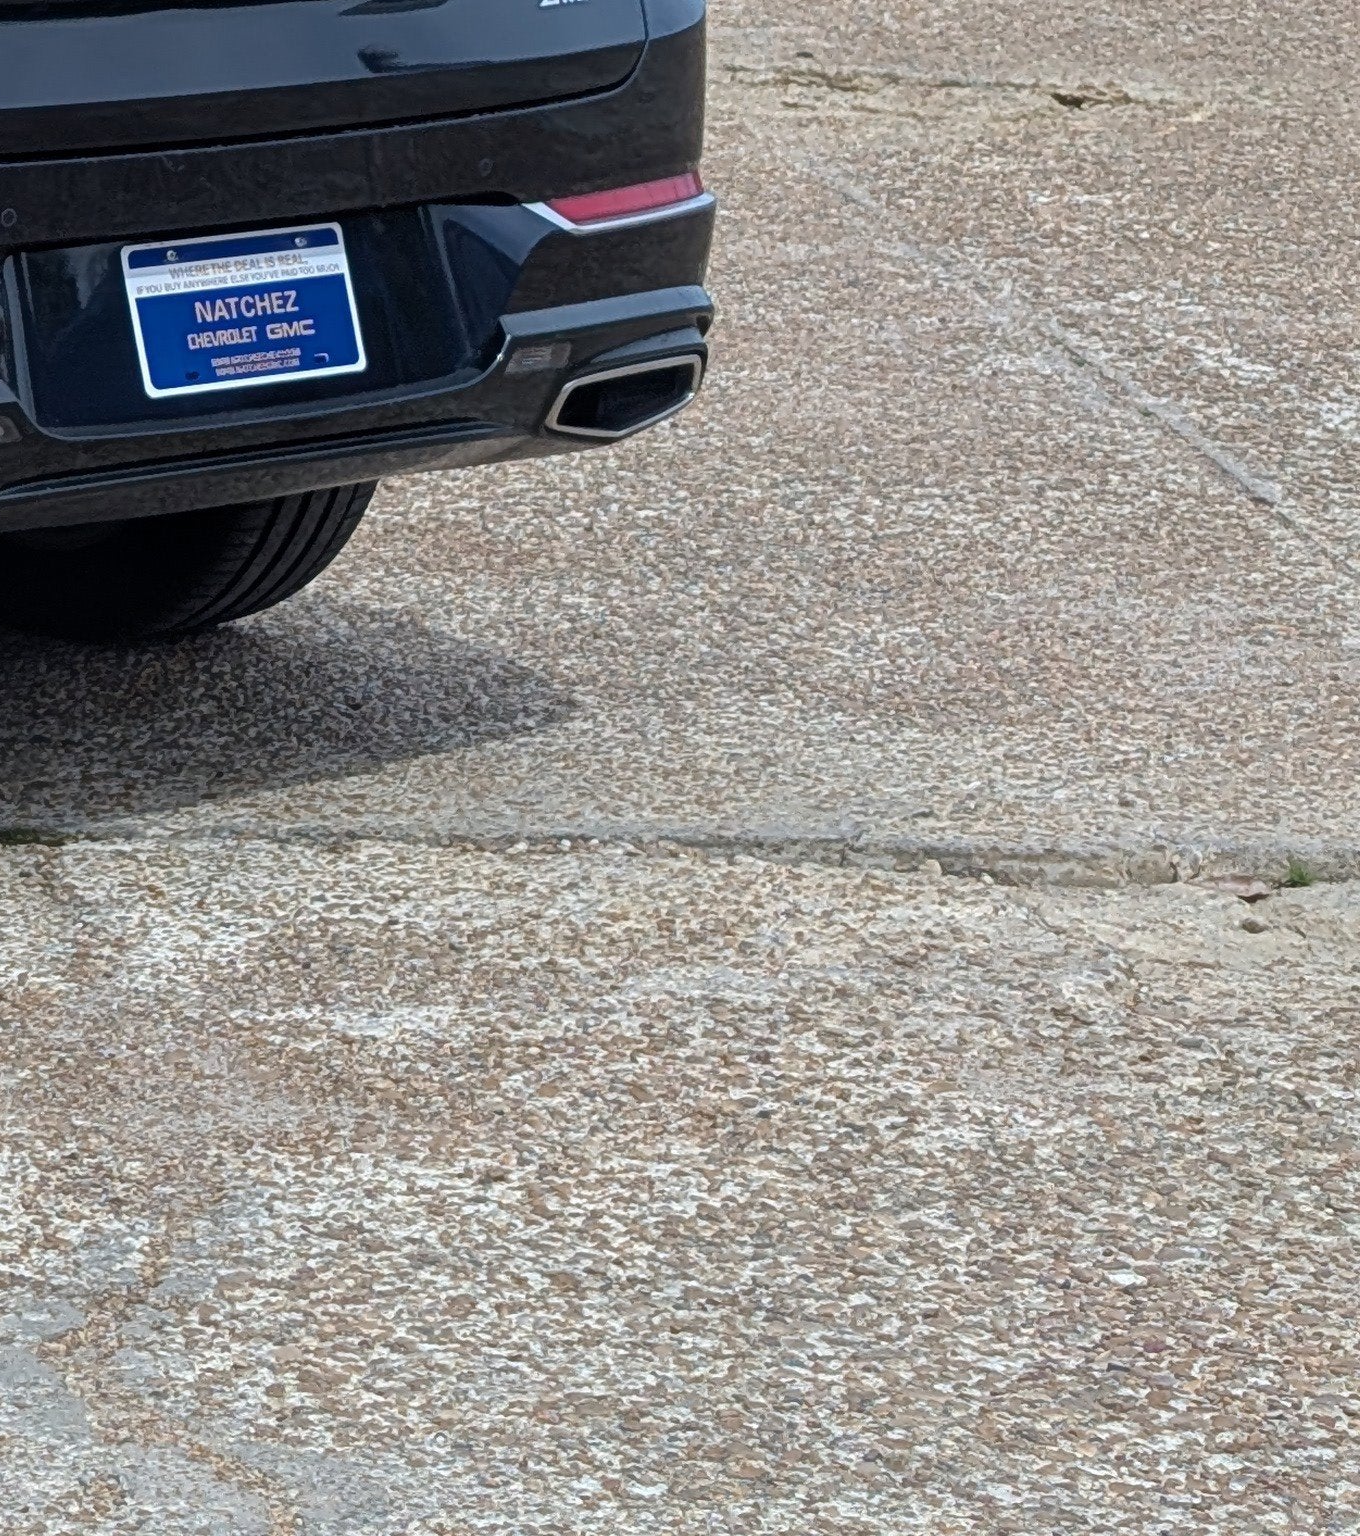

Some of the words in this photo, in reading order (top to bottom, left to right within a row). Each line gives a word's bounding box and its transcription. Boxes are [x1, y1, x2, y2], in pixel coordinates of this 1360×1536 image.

[194, 290, 299, 323] NATCHEZ
[187, 326, 257, 350] CHEVROLET
[266, 319, 315, 340] GMC
